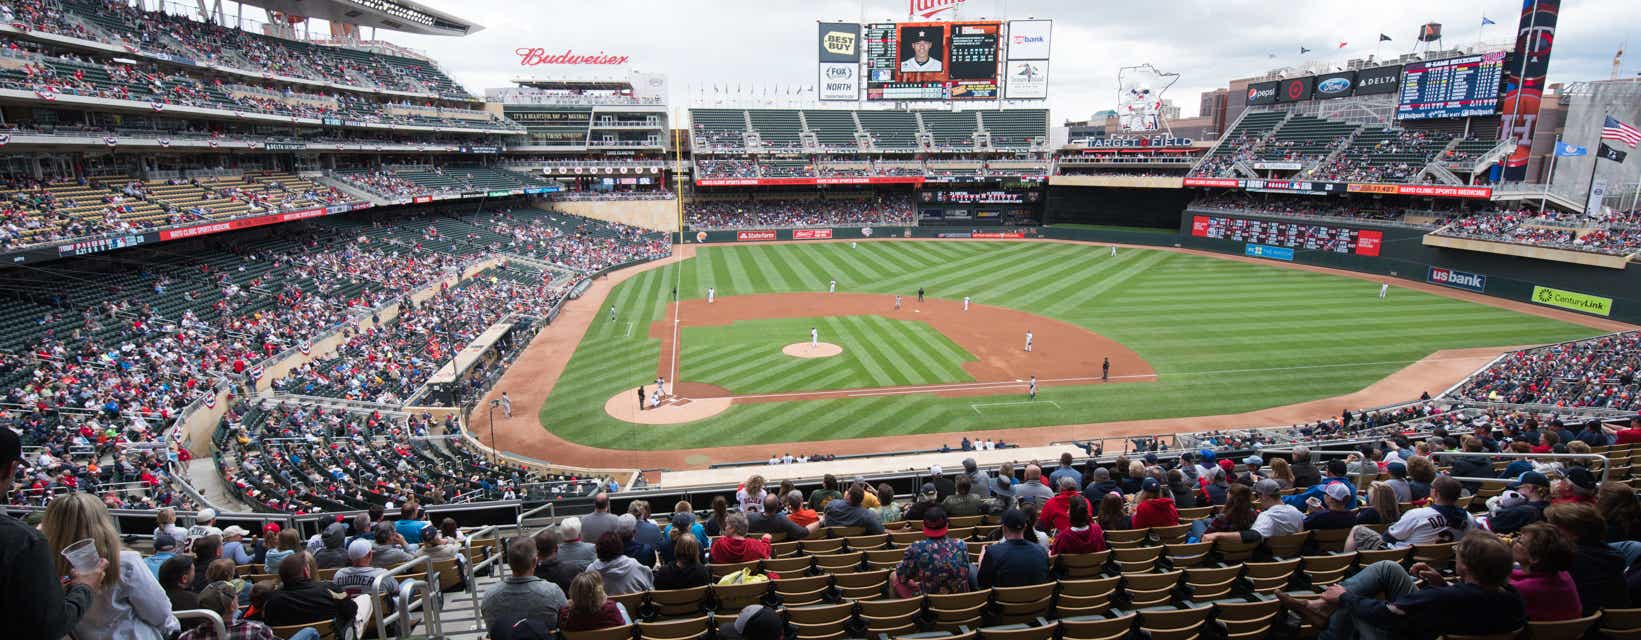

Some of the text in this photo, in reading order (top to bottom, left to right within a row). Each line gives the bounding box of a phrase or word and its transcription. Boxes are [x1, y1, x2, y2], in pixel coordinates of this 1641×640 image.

[828, 34, 854, 43] BEST
[828, 42, 850, 50] BUY
[515, 47, 629, 66] Budweiser
[831, 67, 847, 76] FOX
[1368, 75, 1396, 85] DELTA
[826, 82, 852, 91] NORTH
[1323, 81, 1346, 92] Ford
[1257, 87, 1275, 98] pepsi
[1088, 138, 1192, 148] TARGET FIELD
[170, 229, 184, 239] MAYO
[184, 227, 198, 236] CLINIC
[198, 226, 213, 234] SPORTS
[1432, 268, 1481, 288] usbank
[1554, 293, 1604, 310] CenturyLink
